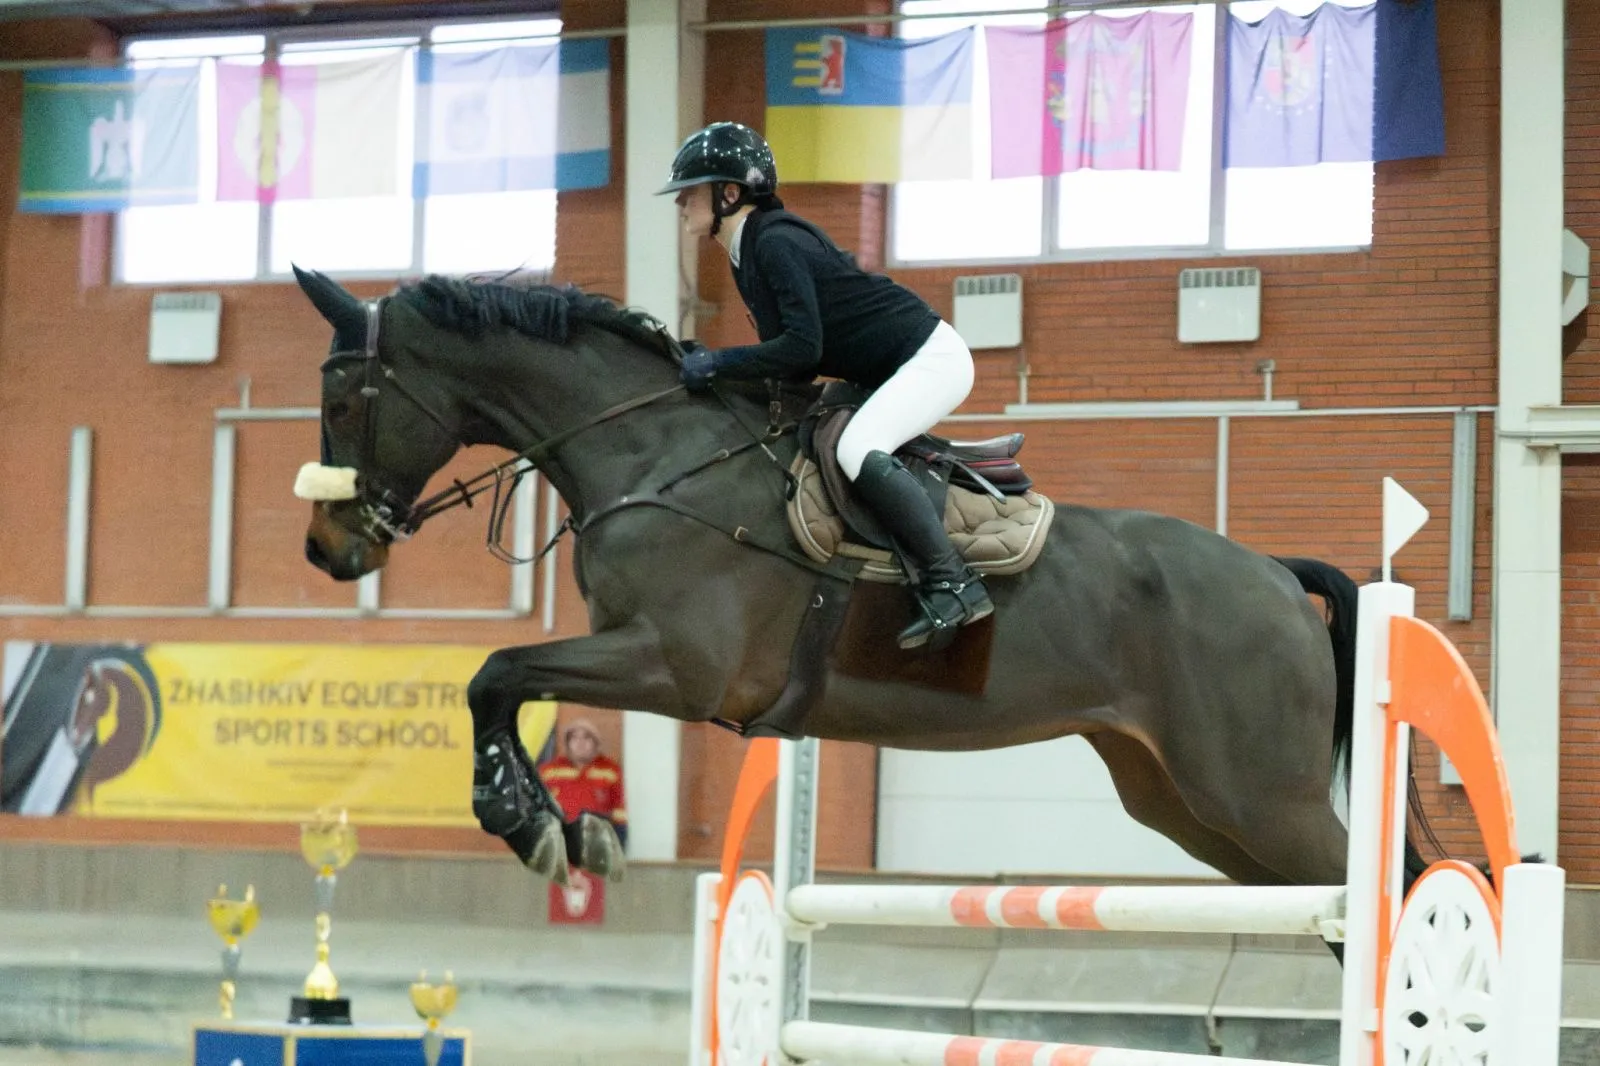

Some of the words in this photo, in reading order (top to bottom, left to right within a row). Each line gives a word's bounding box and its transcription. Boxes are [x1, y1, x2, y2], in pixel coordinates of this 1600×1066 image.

[168, 679, 314, 706] ZHASHKIV
[322, 682, 468, 709] EQUESTRI
[214, 718, 328, 745] SPORTS
[336, 720, 460, 749] SCHOOL
